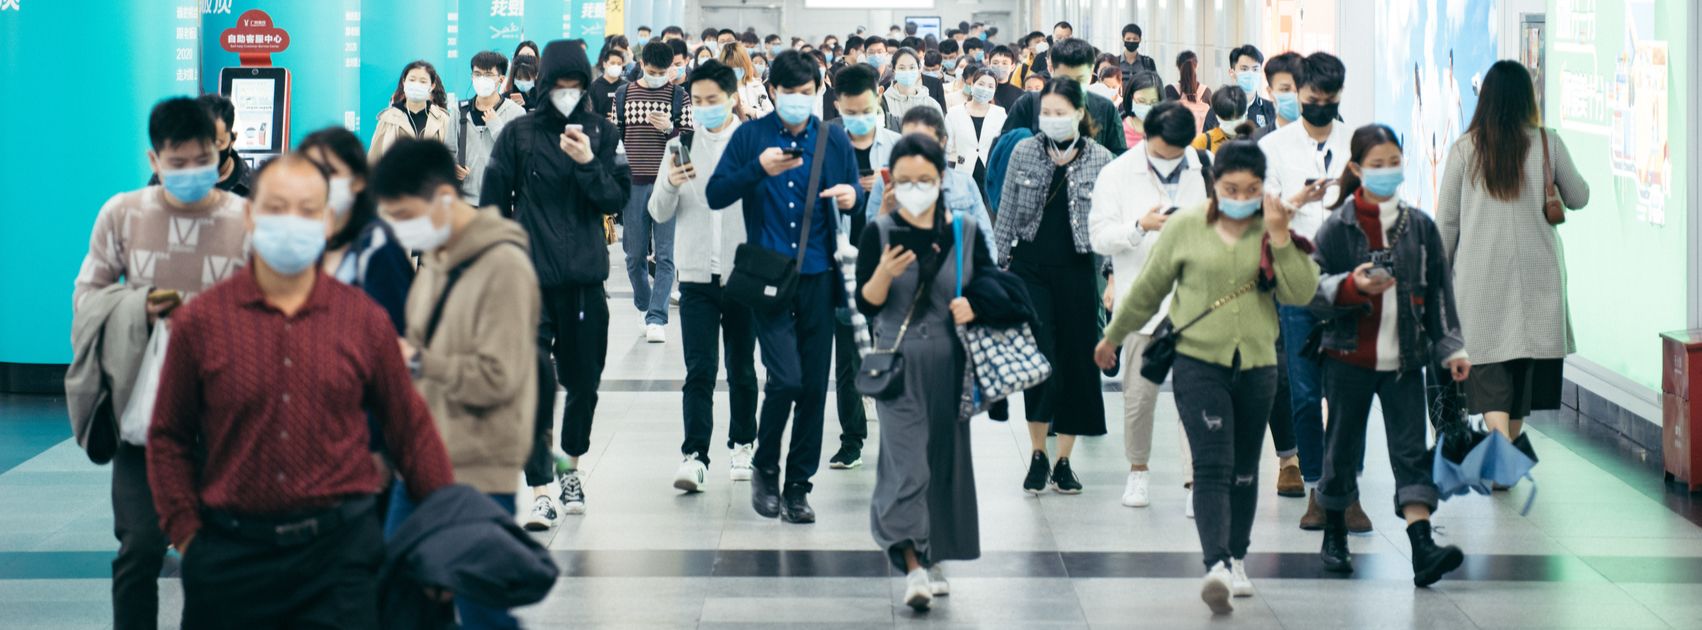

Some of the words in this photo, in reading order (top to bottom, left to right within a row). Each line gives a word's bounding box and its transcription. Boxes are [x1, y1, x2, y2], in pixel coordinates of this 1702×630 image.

[227, 34, 282, 44] 自助客服中心
